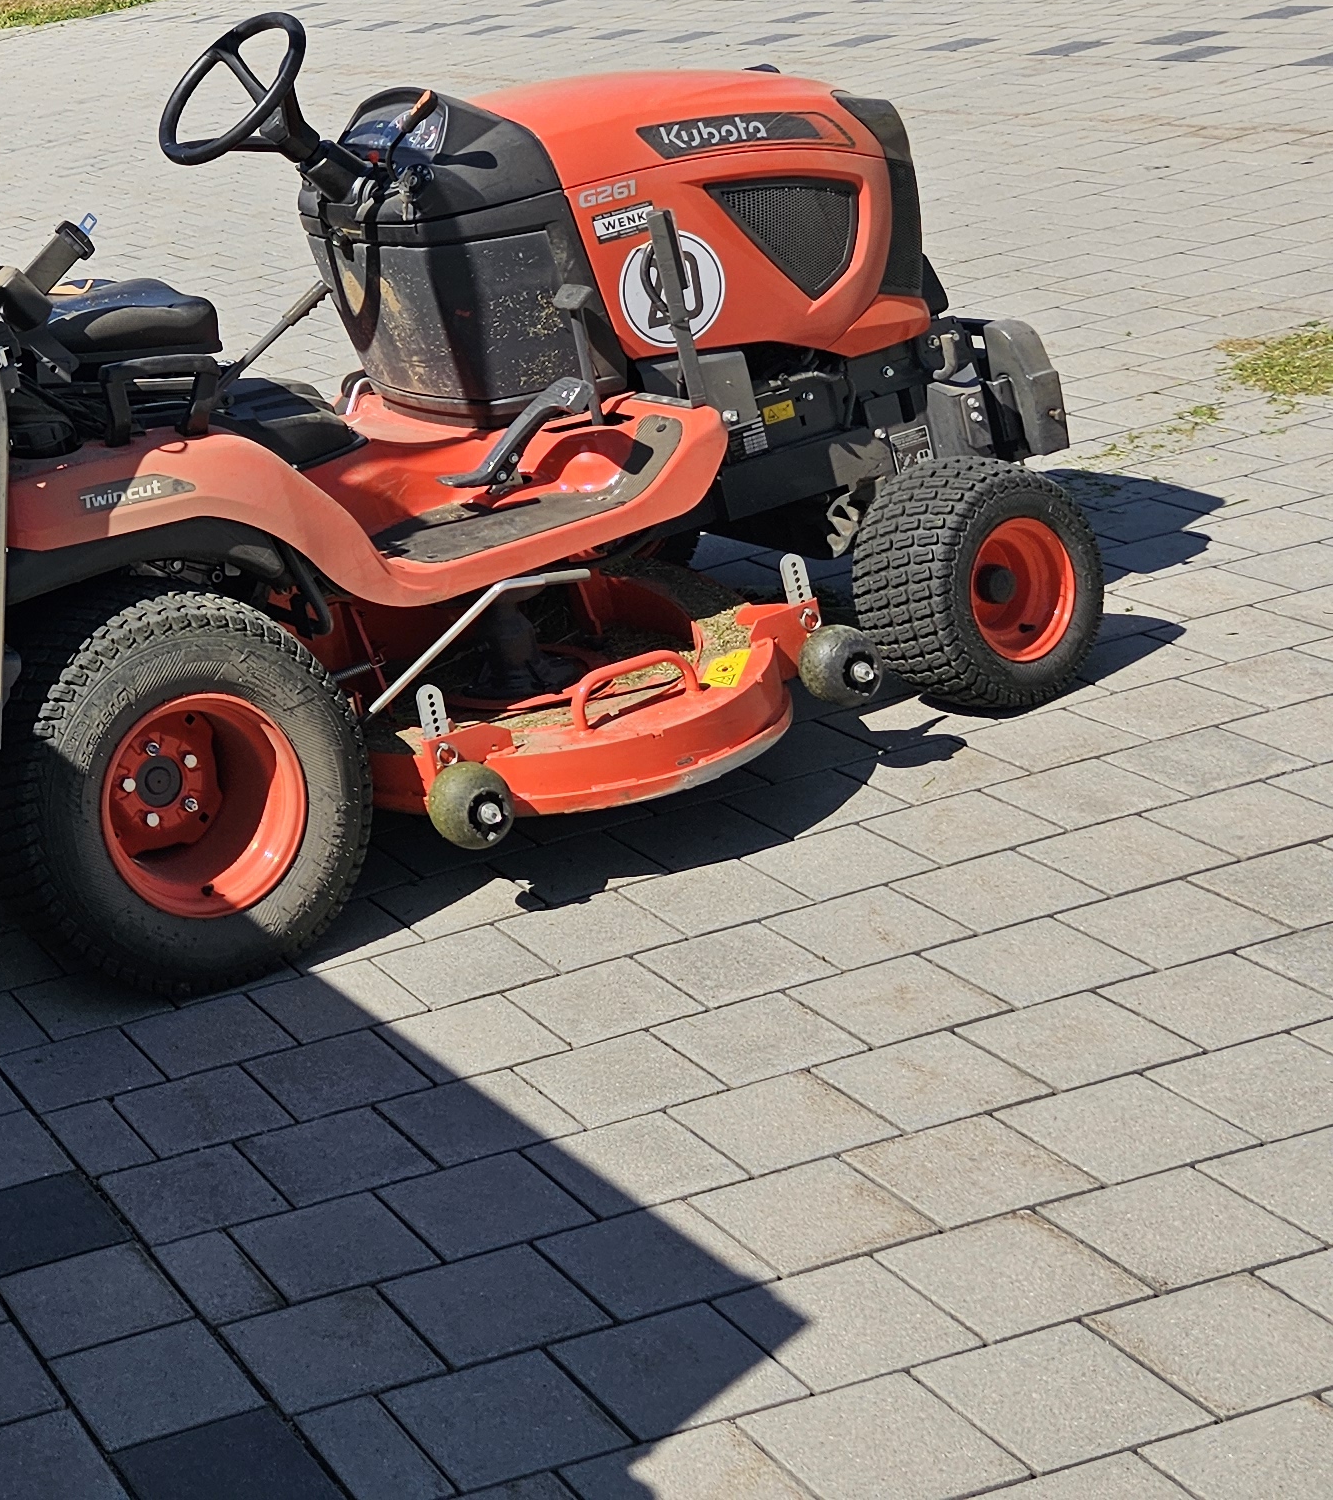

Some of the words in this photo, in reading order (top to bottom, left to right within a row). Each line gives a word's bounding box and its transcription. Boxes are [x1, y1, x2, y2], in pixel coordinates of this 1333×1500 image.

[659, 116, 767, 148] Kubota
[578, 179, 636, 209] G261
[602, 211, 647, 231] WENK
